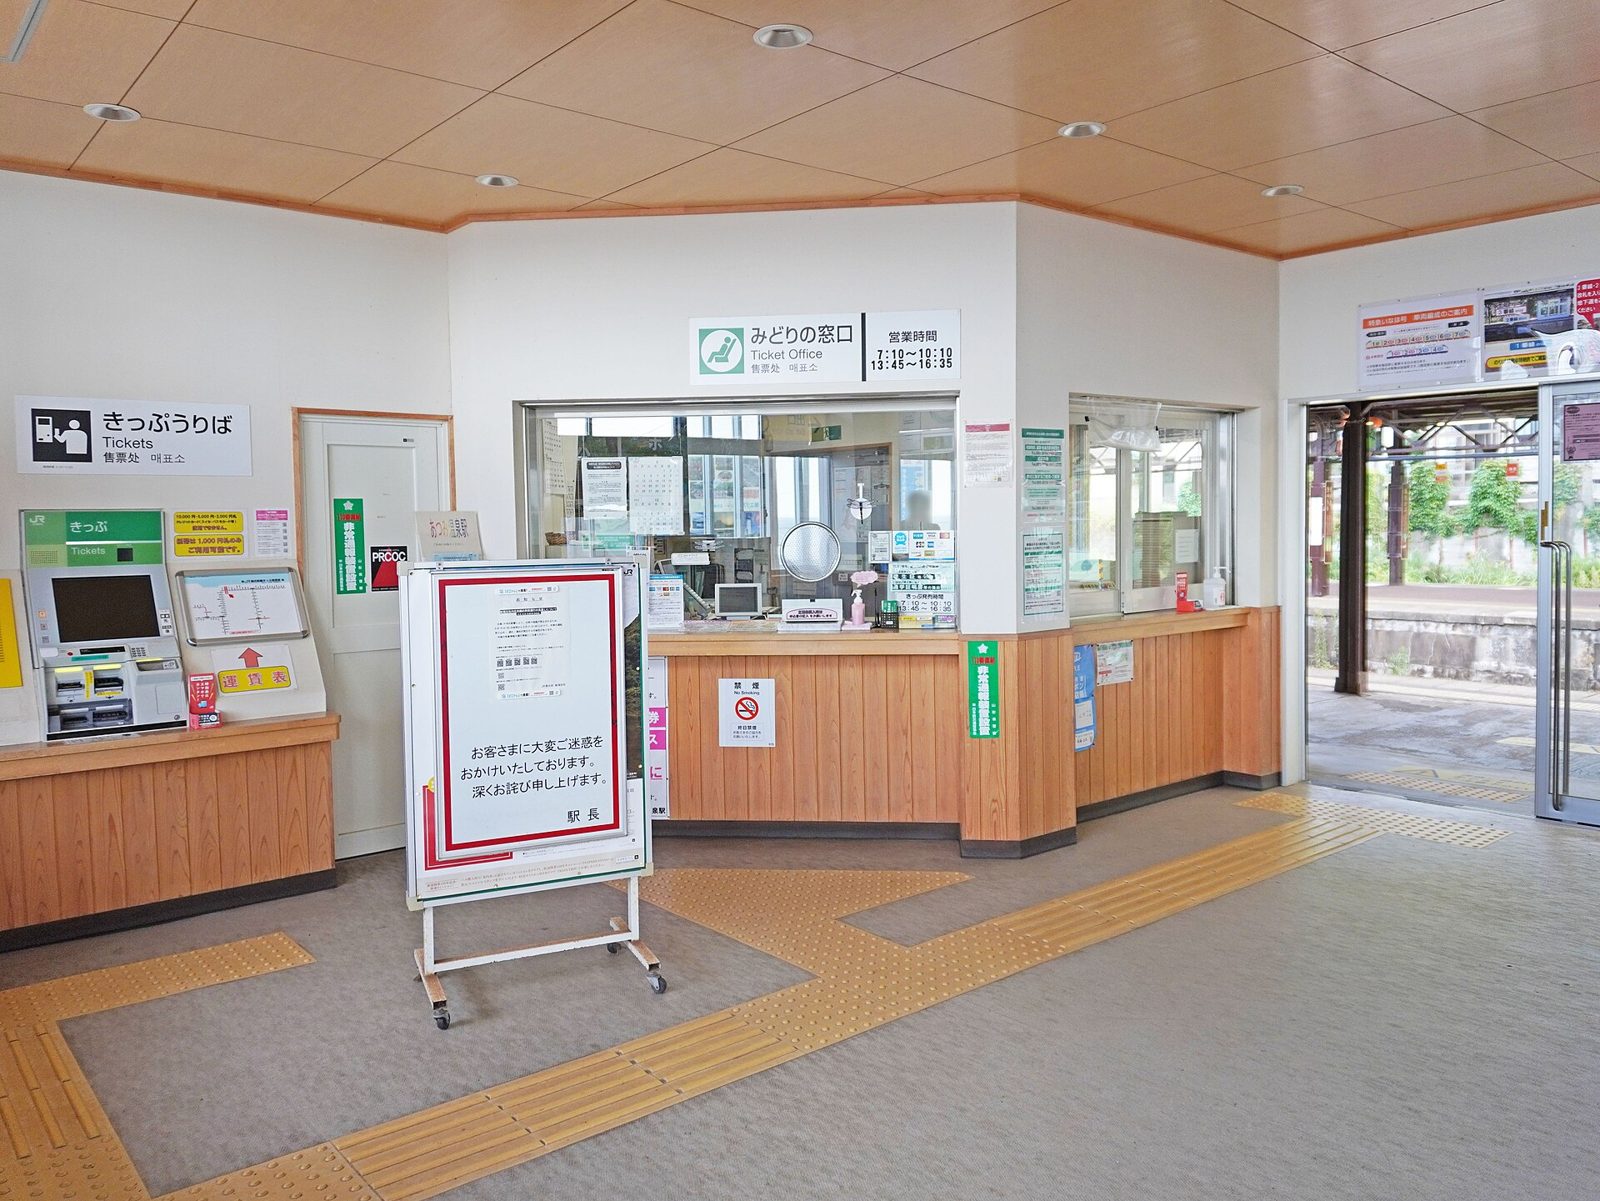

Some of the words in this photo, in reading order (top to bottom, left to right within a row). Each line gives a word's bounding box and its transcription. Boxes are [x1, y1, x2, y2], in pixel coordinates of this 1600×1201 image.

[750, 325, 853, 345] みどりの窓口
[888, 330, 938, 343] 営業時間
[750, 349, 785, 360] Ticket
[788, 348, 823, 359] Office
[751, 363, 780, 374] 售票处
[789, 362, 818, 373] 매표소
[102, 411, 233, 435] きっぷうりば
[102, 436, 154, 449] Tickets
[103, 452, 140, 464] 售票处
[150, 453, 186, 464] 매표소
[30, 515, 45, 523] JR
[70, 521, 108, 533] きっぷ
[71, 547, 106, 555] Tickets
[372, 551, 406, 562] PRCOC
[623, 568, 634, 576] JR
[471, 735, 604, 760] お客さまに大変ご迷惑を
[460, 755, 595, 781] おかけいたしております。
[472, 772, 607, 799] 深くお詫び申し上げます。
